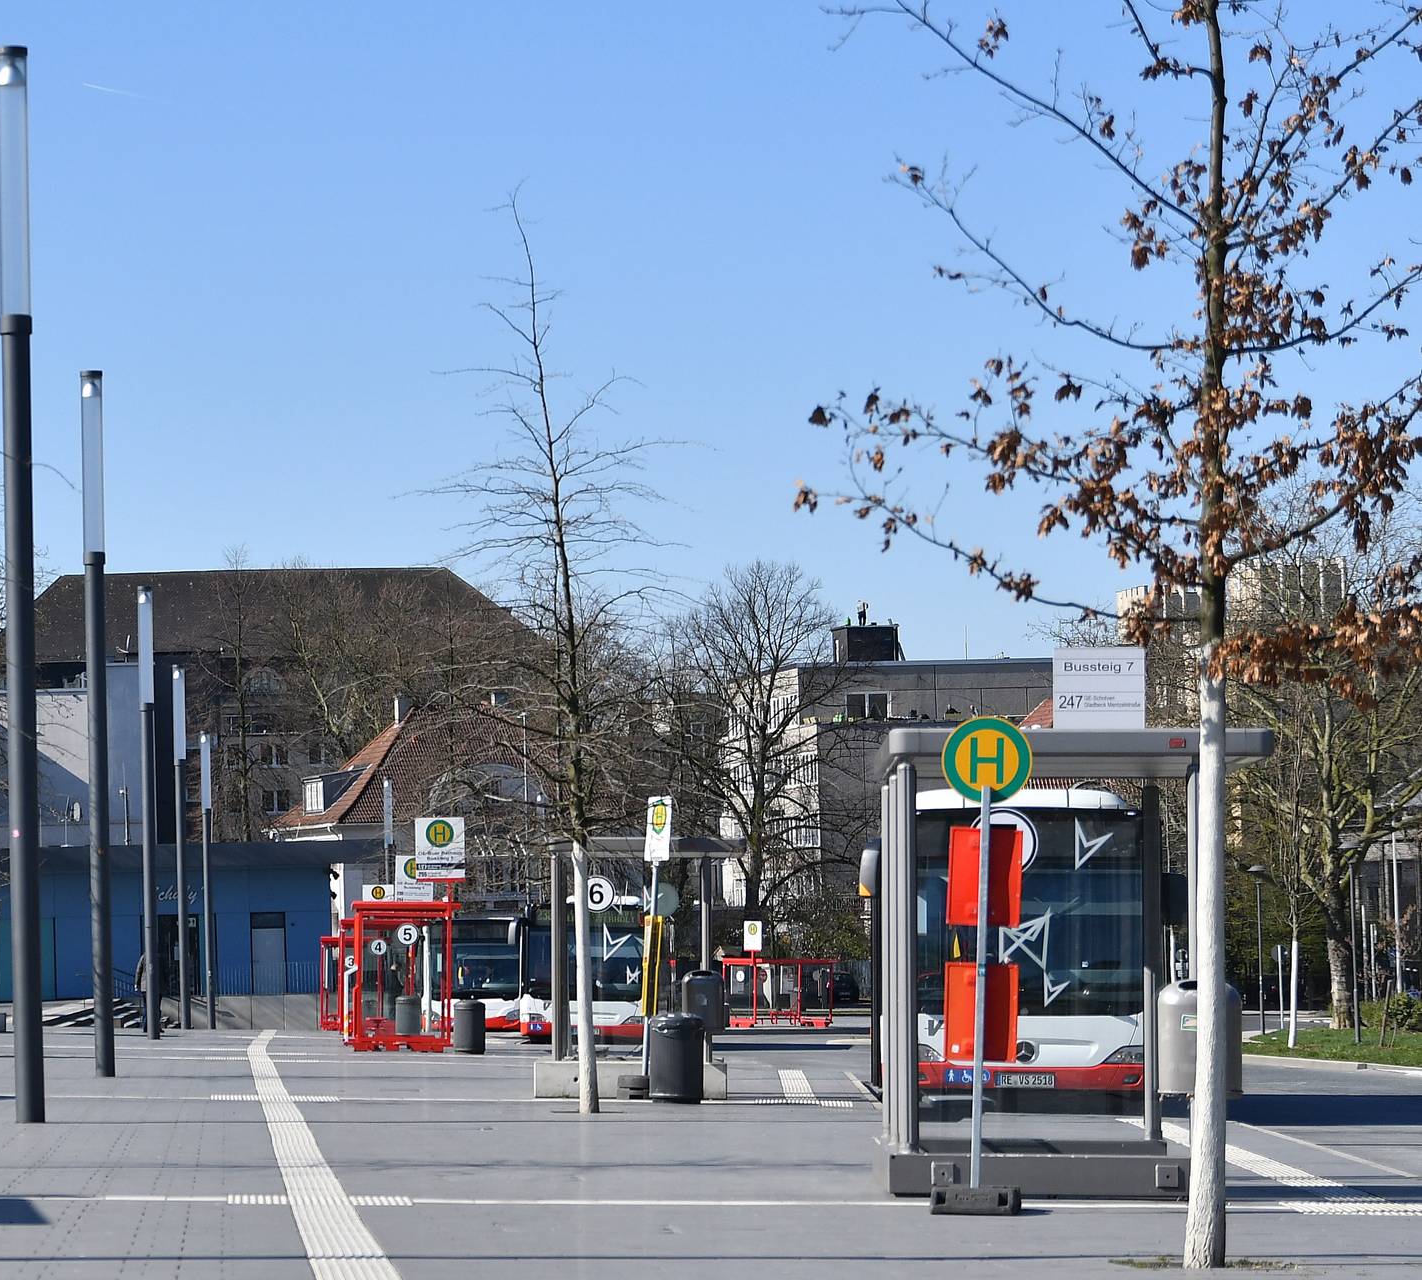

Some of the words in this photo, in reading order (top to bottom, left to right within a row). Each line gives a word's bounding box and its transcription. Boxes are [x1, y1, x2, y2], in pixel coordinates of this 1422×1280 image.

[1063, 661, 1122, 674] Bussteig
[1126, 661, 1134, 672] 7
[1058, 695, 1083, 709] 247
[969, 736, 1005, 785] H
[434, 826, 446, 842] H
[589, 883, 604, 905] 6
[403, 928, 412, 941] 5
[374, 942, 382, 952] 4
[348, 958, 355, 966] 3
[1001, 1075, 1012, 1085] RE
[1019, 1075, 1030, 1085] VS
[1032, 1075, 1053, 1085] 2518
